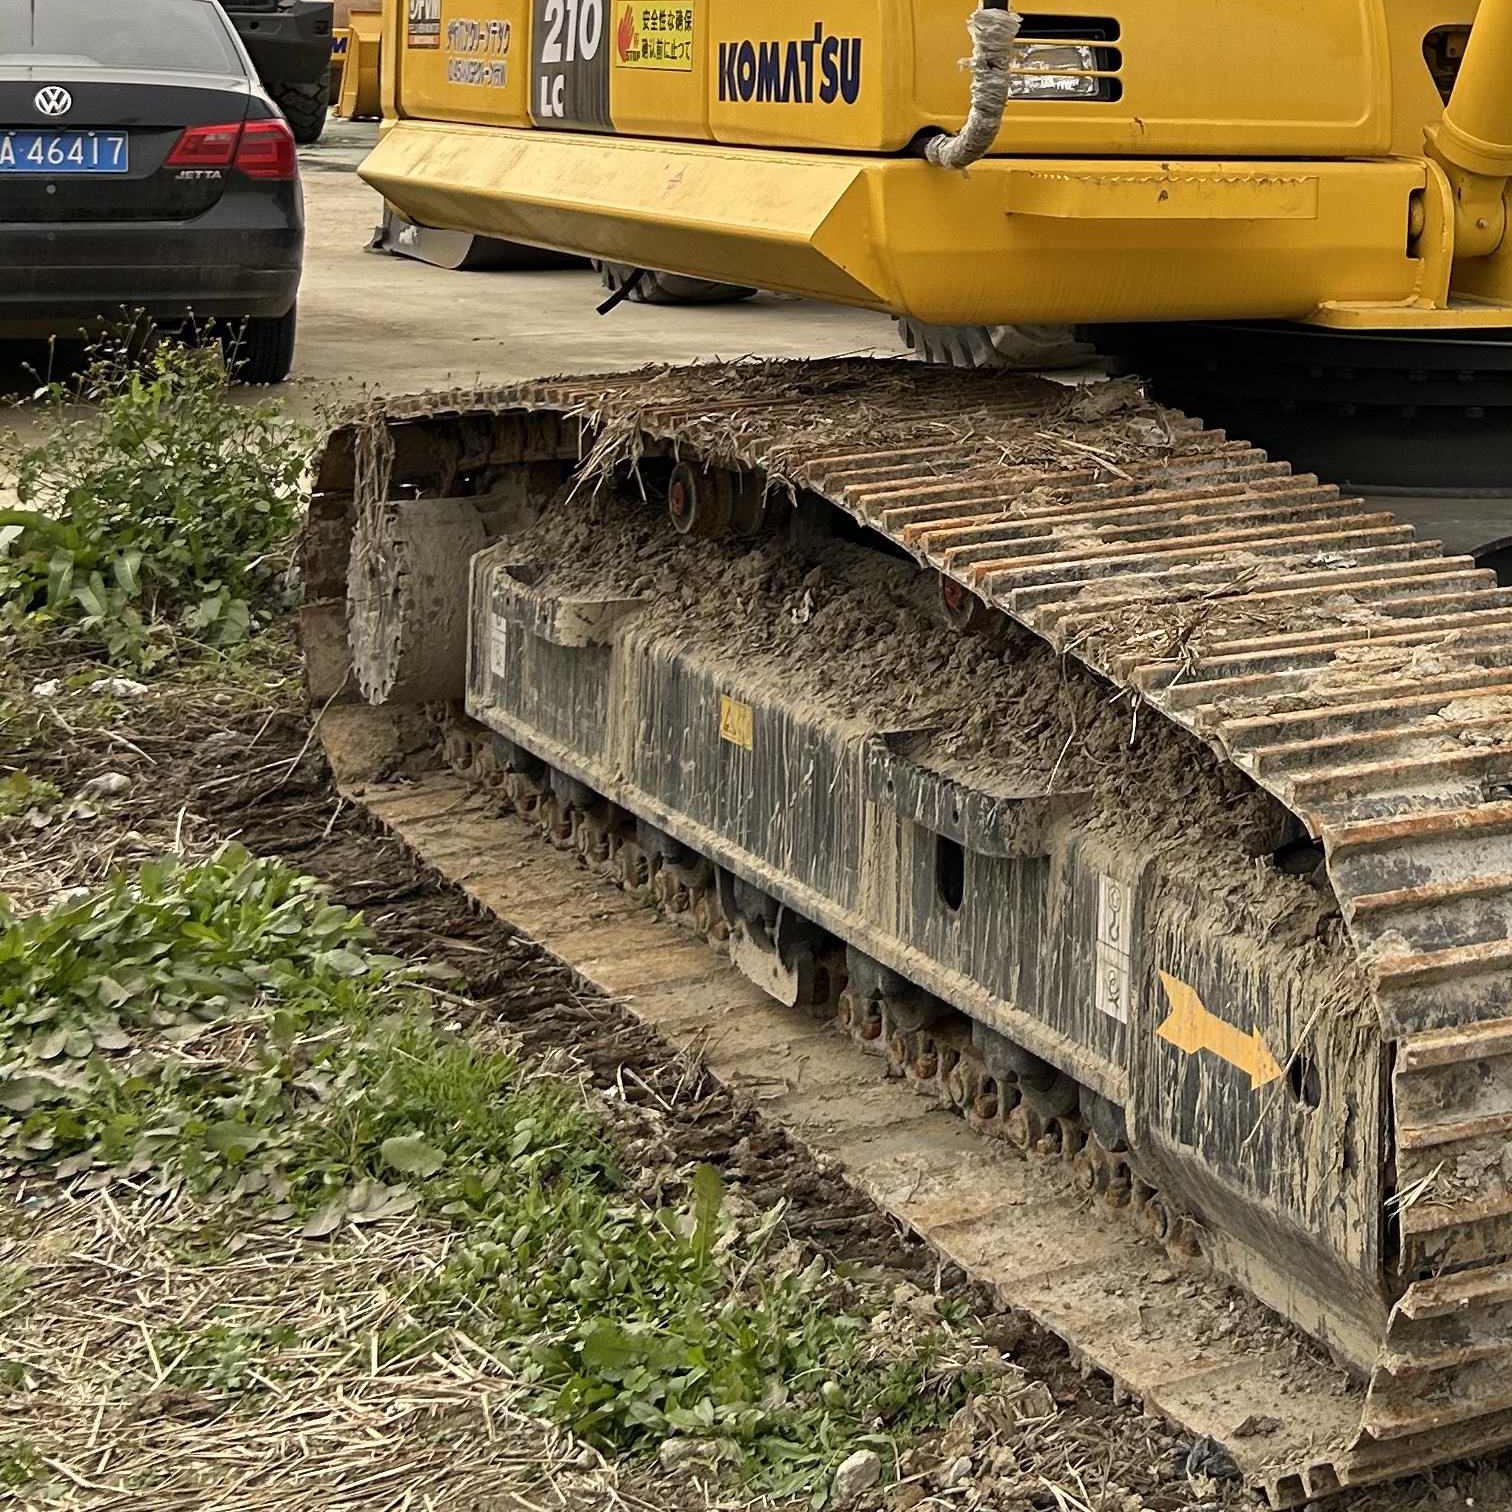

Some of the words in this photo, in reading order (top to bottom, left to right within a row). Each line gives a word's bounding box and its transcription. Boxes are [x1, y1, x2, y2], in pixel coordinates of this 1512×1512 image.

[718, 21, 862, 104] KOMATSU
[540, 74, 565, 118] LC
[174, 170, 223, 180] JETTA
